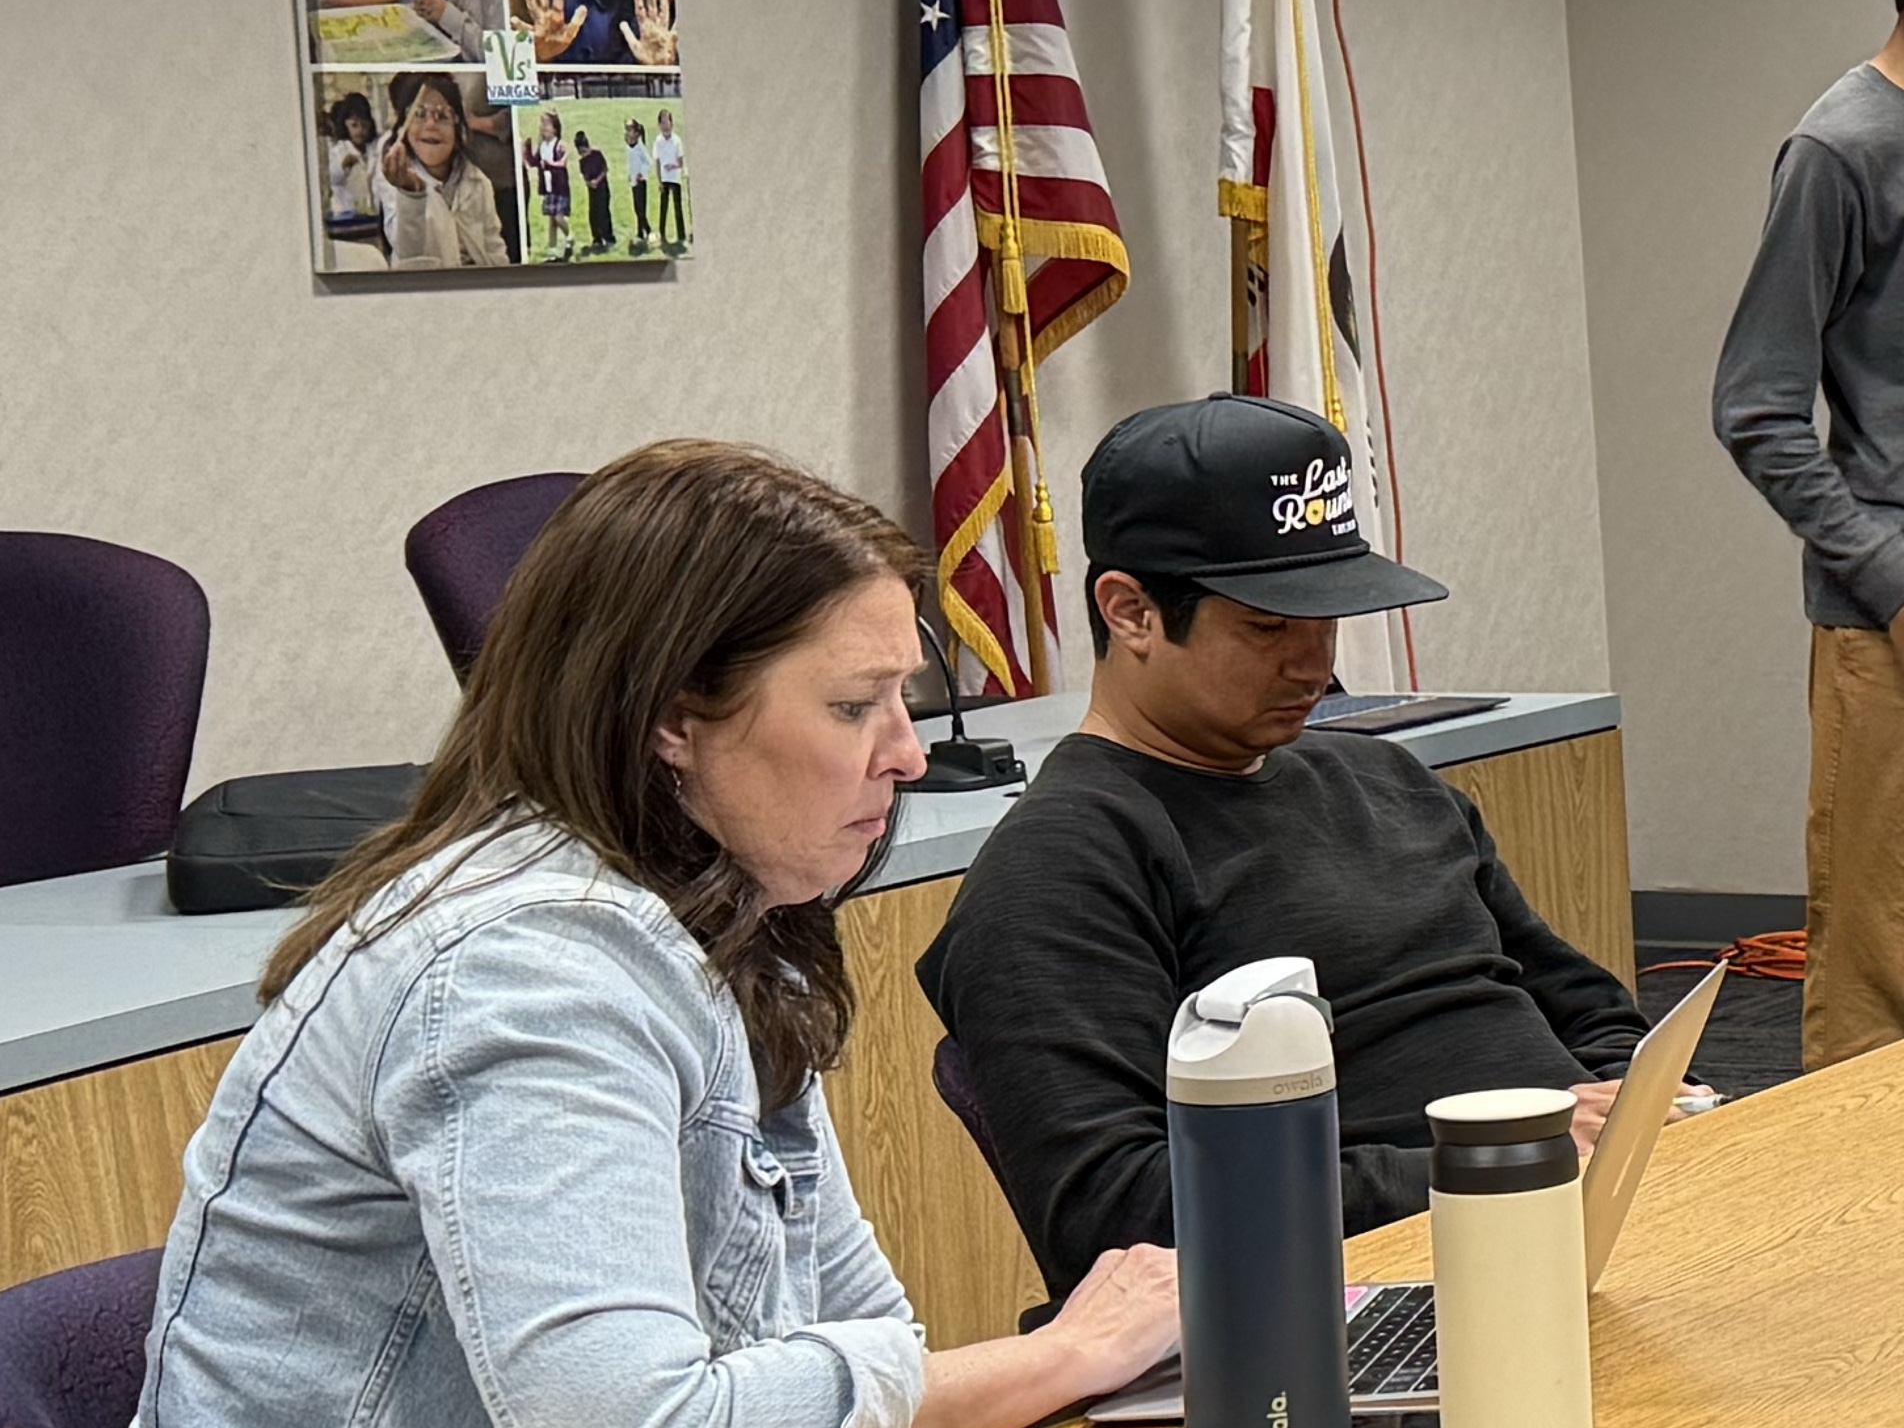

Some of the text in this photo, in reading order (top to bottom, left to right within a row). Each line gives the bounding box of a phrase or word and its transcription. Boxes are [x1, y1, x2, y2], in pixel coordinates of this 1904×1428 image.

[487, 84, 540, 99] VARGAS
[1270, 474, 1299, 487] THE
[1273, 1074, 1324, 1095] owala
